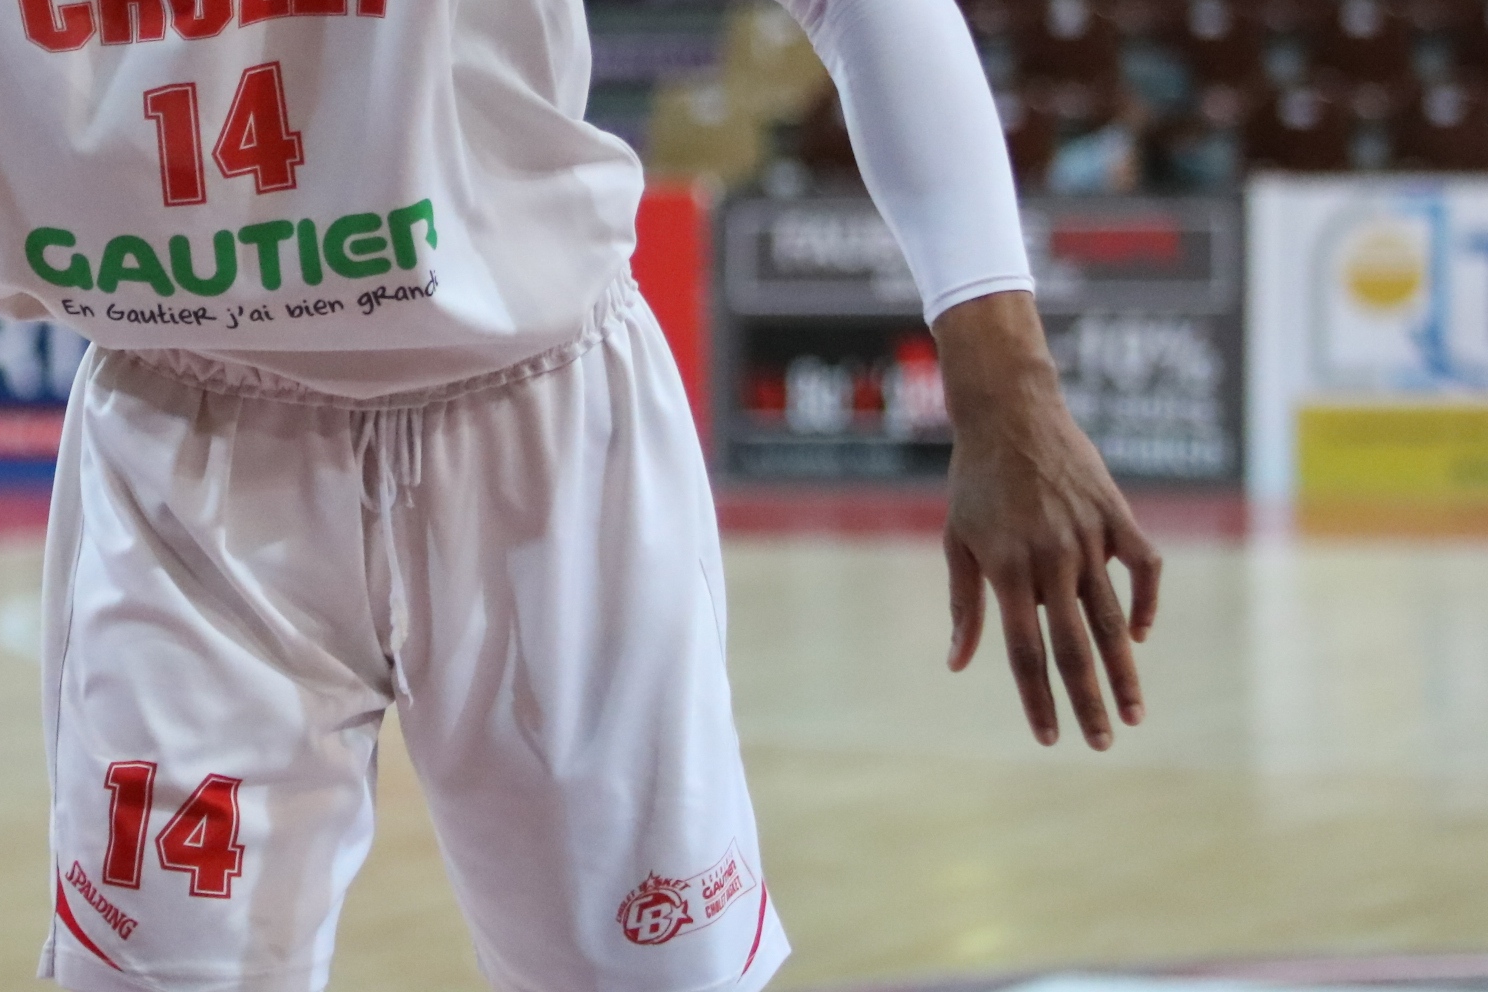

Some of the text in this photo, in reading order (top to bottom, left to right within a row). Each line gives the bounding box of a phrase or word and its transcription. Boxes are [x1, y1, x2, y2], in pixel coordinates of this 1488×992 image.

[143, 61, 305, 207] 14
[25, 198, 438, 297] GAUTIER
[61, 298, 95, 319] En
[226, 303, 274, 329] j'ai
[287, 297, 344, 320] bien
[102, 760, 245, 899] 14
[65, 860, 139, 941] SPALDING
